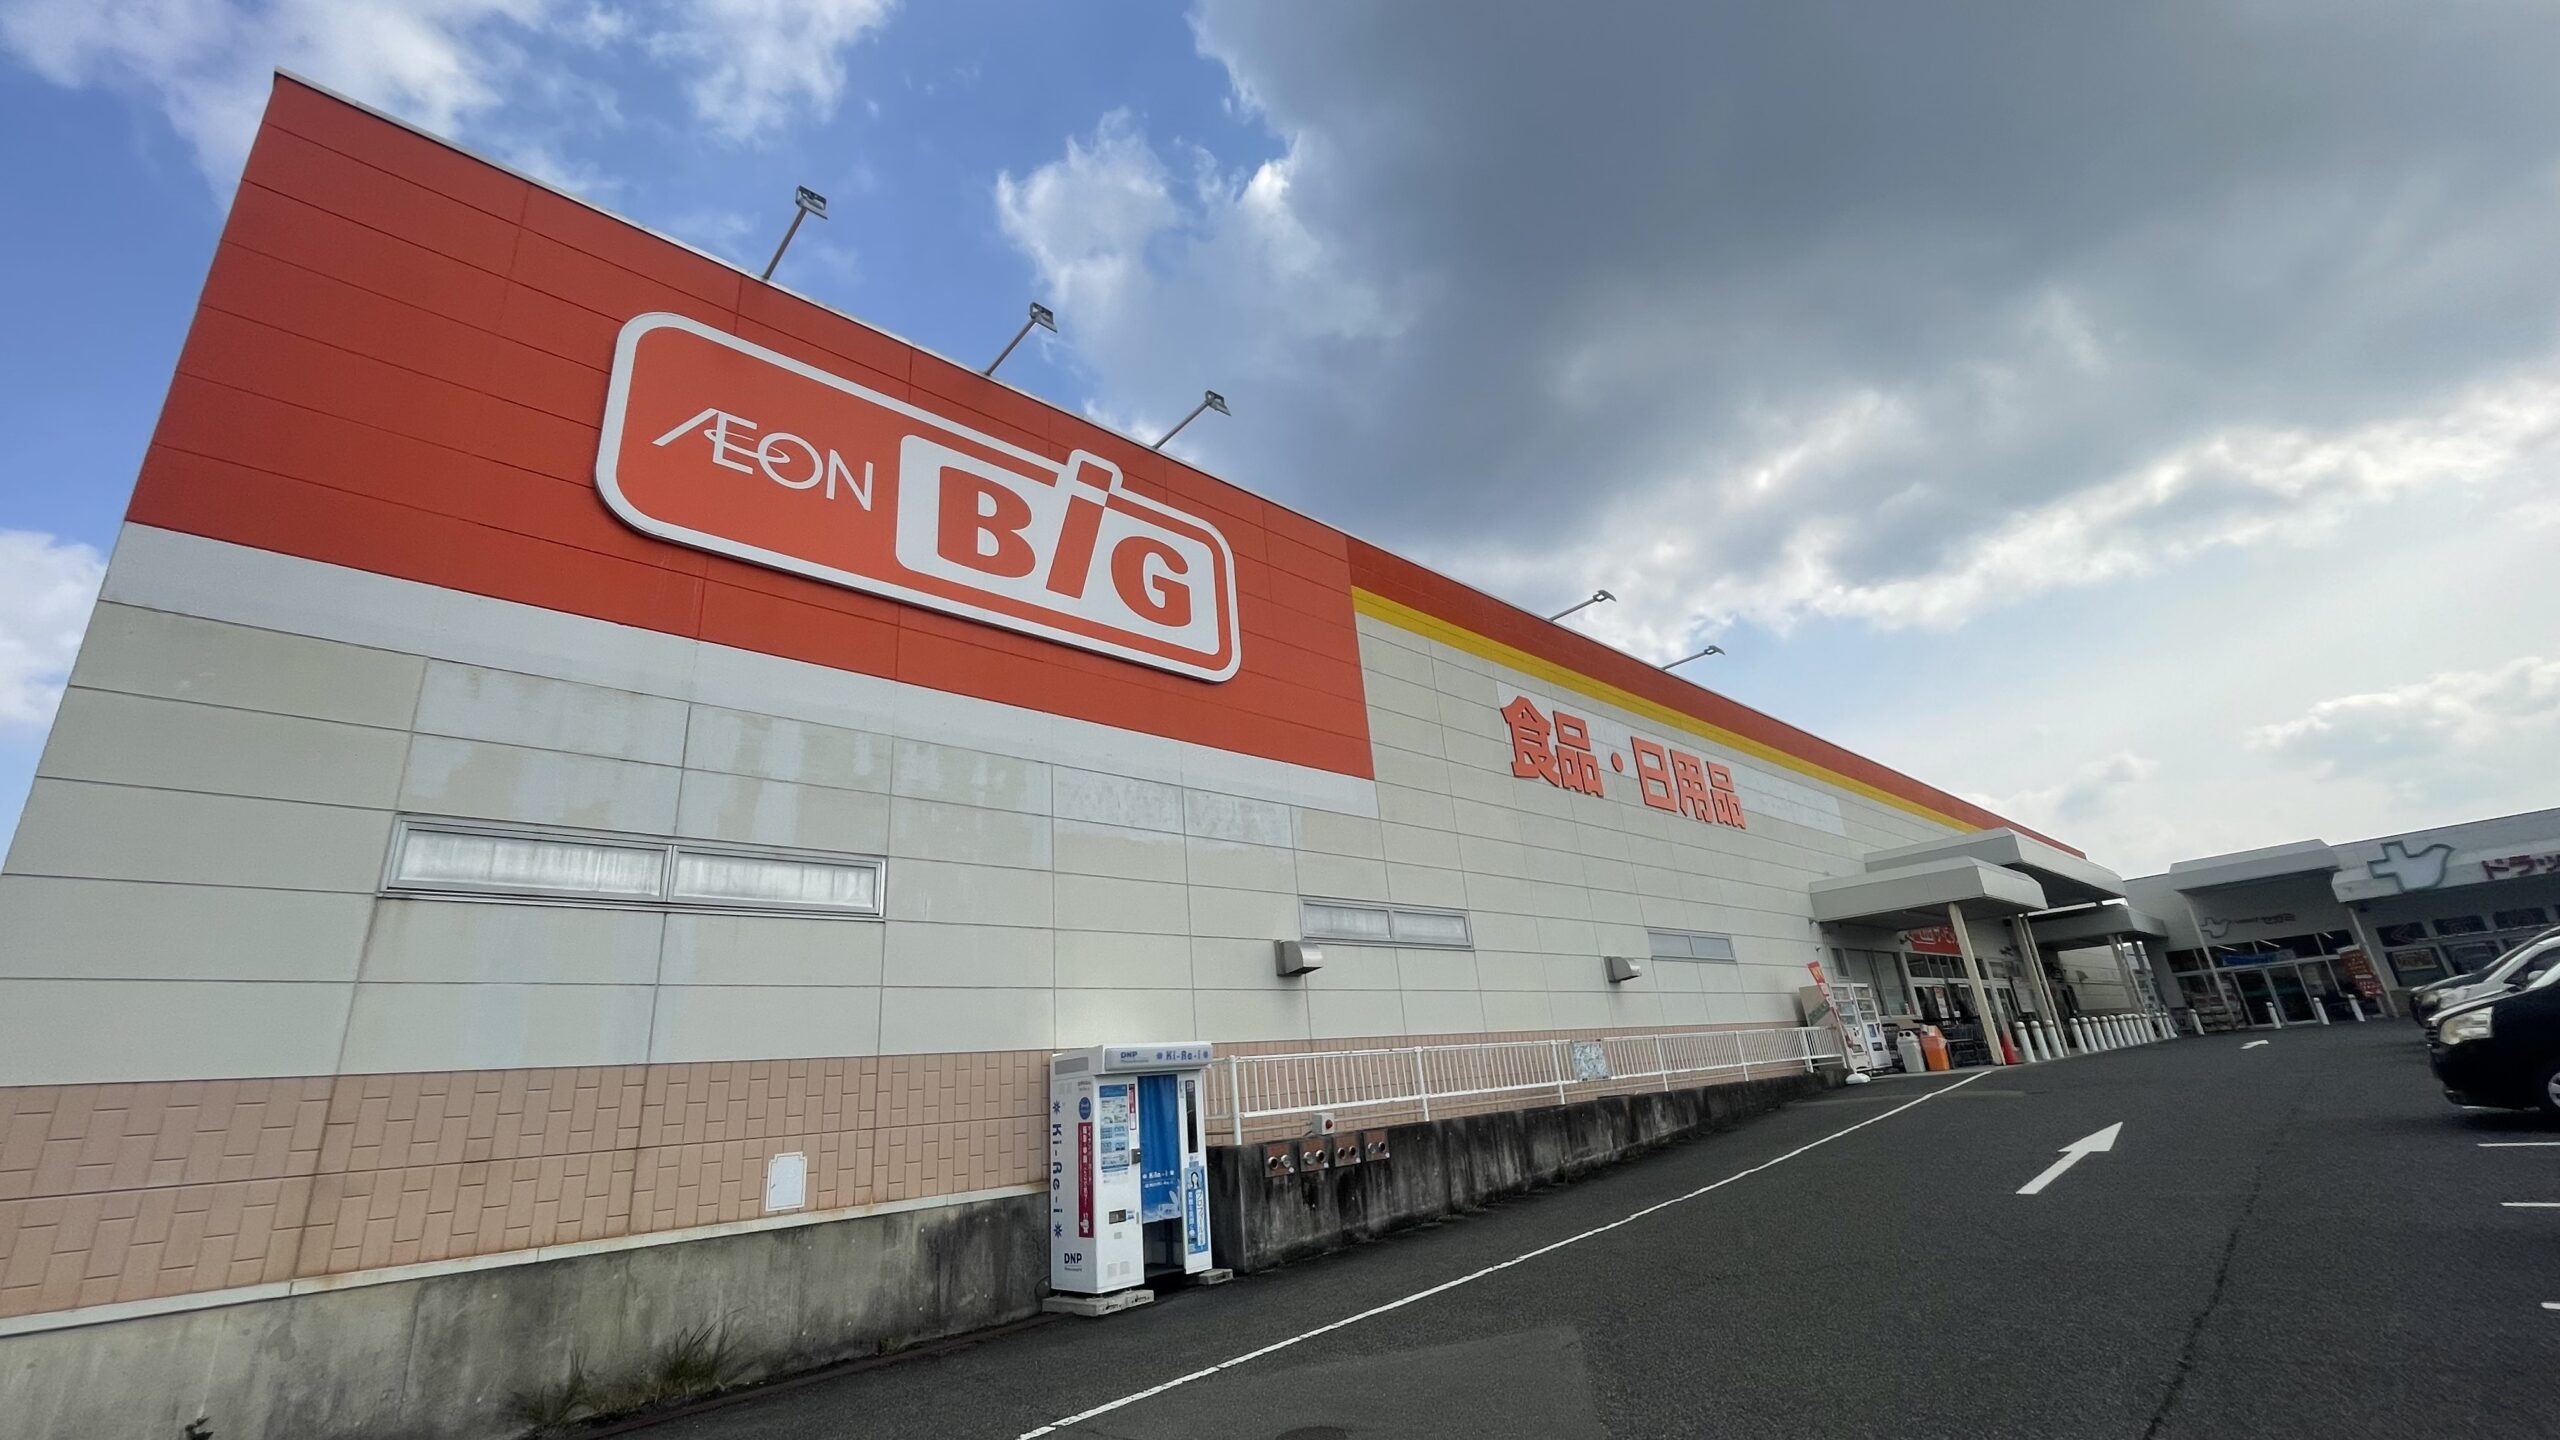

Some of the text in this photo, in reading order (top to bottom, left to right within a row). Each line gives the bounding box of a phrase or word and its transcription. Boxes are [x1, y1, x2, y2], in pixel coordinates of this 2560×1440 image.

[1500, 695, 1746, 829] 食品・日用品
[1120, 1051, 1138, 1059] DNP
[1064, 1252, 1083, 1265] DNP
